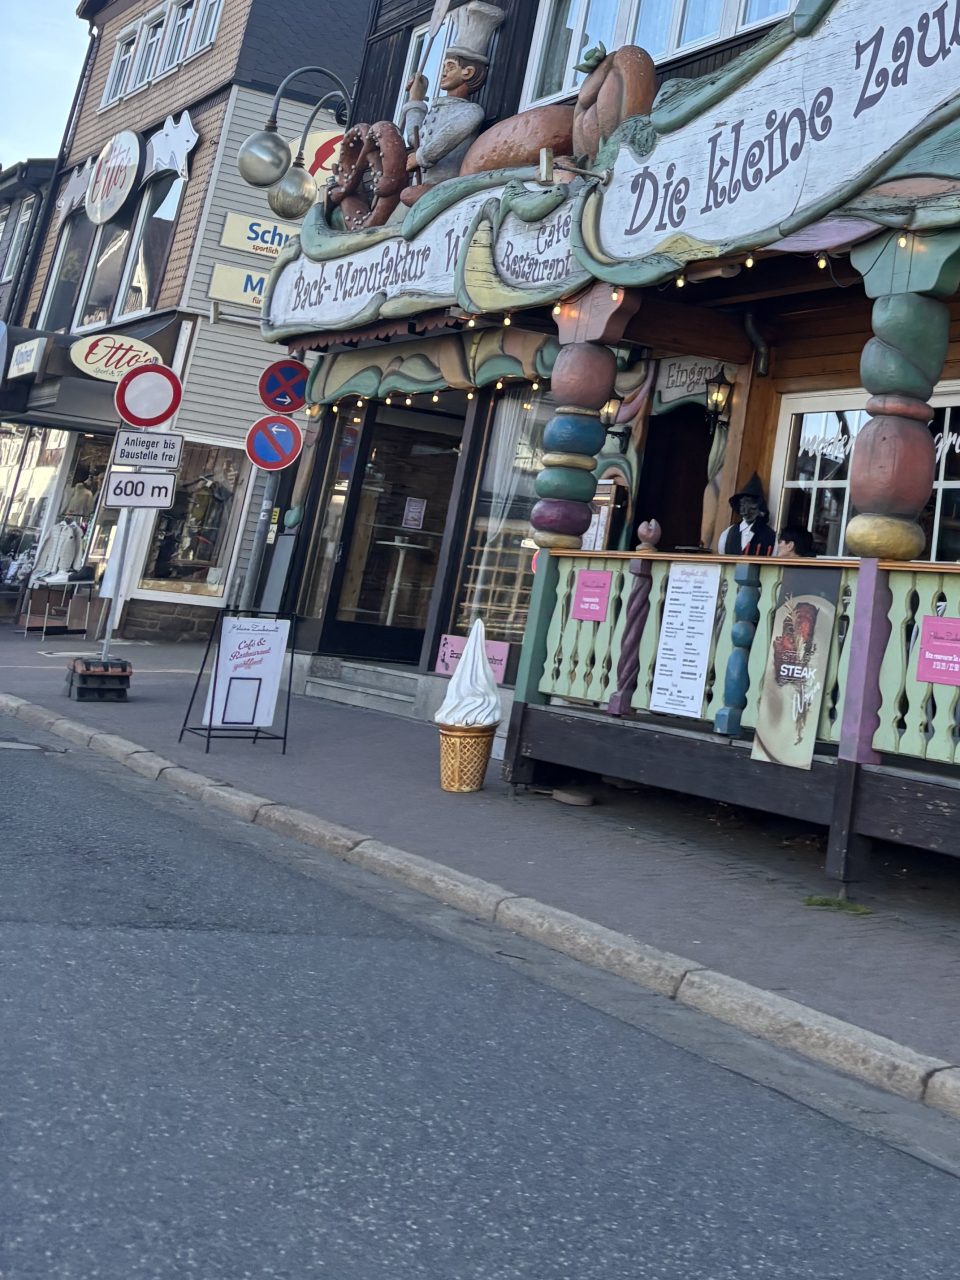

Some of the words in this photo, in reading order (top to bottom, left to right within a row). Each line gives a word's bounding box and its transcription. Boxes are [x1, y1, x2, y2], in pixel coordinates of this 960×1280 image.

[624, 162, 690, 236] Die
[537, 203, 574, 254] Café
[252, 244, 279, 255] sportlich
[501, 241, 572, 283] Restaurant
[124, 437, 160, 450] Anlieger
[163, 439, 176, 450] bis
[120, 448, 158, 461] Baustelle
[161, 451, 176, 462] frei
[113, 480, 145, 497] 600
[151, 485, 169, 498] m
[256, 637, 266, 647] &
[780, 663, 817, 680] STEAK
